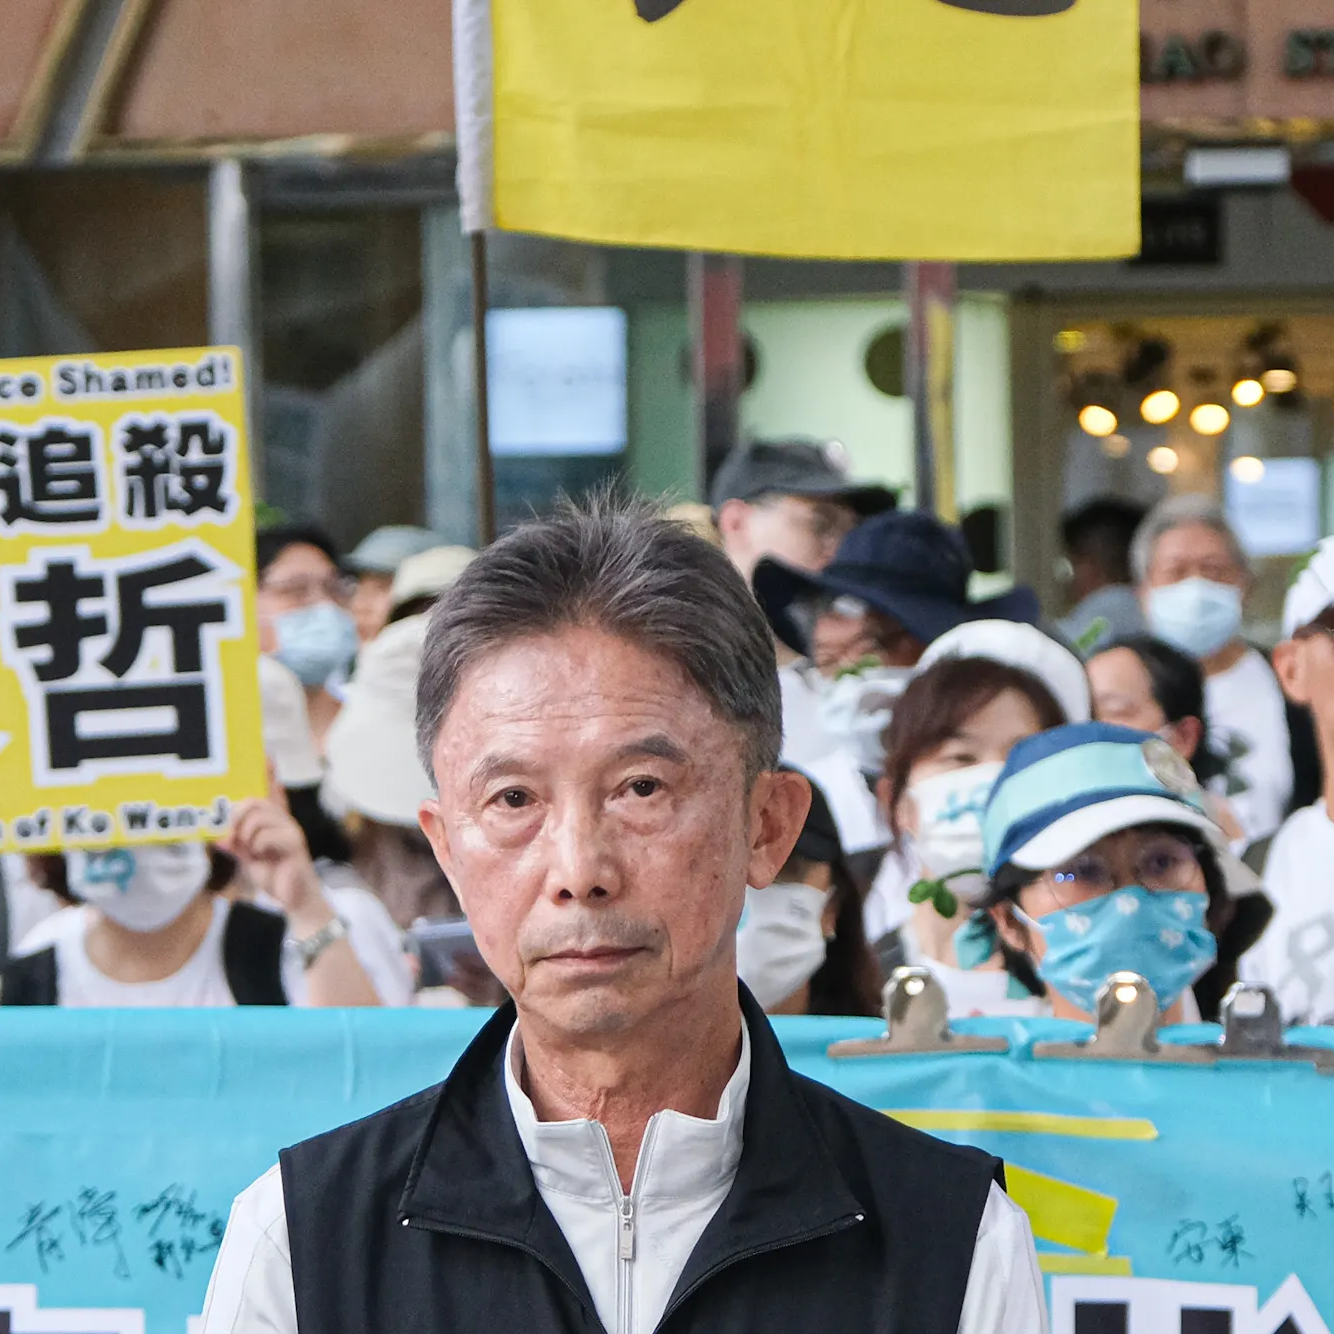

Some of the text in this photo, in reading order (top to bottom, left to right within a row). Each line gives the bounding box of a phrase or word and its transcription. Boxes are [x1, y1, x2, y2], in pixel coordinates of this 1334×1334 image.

[56, 358, 233, 398] Shamed!
[11, 808, 50, 838] of
[63, 805, 114, 835] Ko
[126, 800, 232, 833] Wen-J
